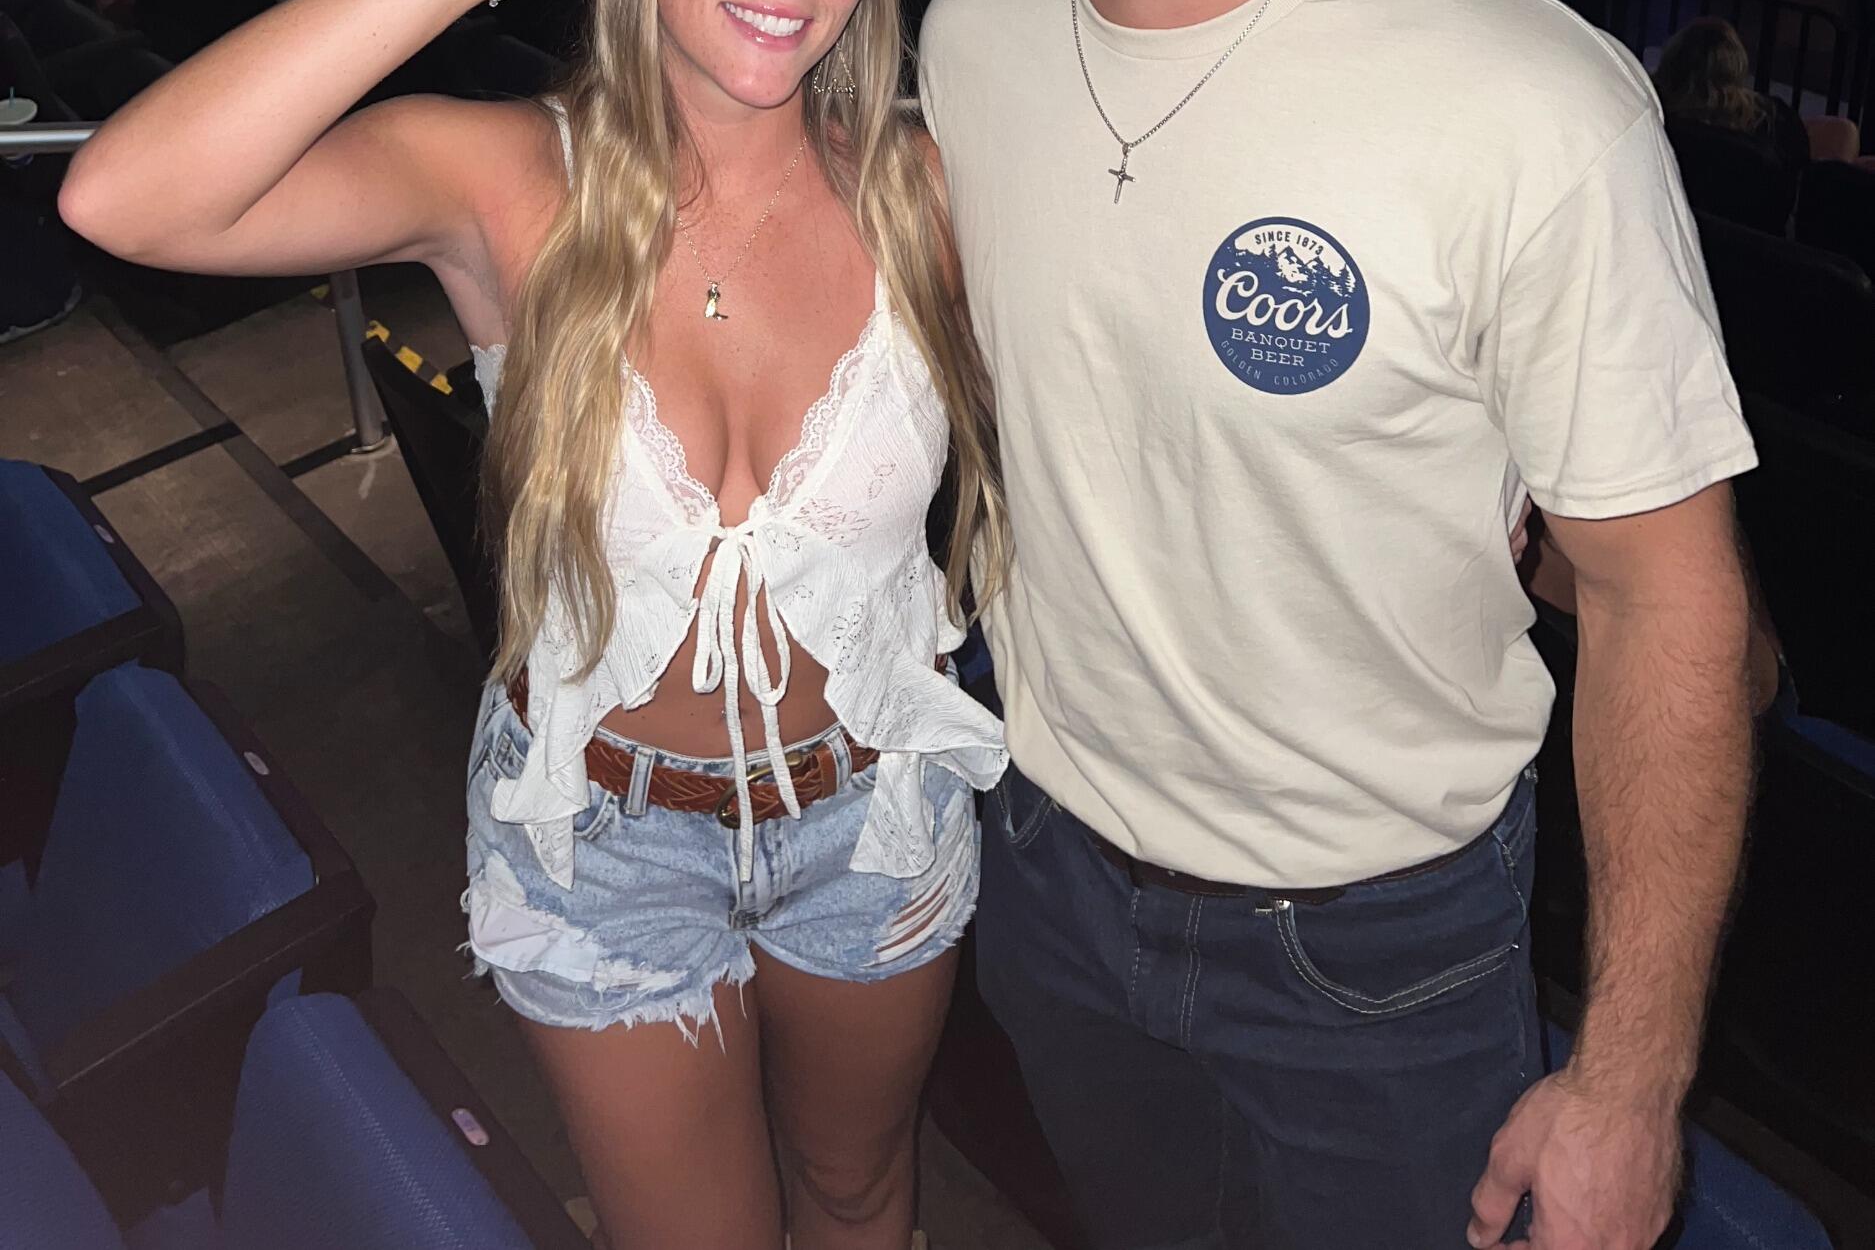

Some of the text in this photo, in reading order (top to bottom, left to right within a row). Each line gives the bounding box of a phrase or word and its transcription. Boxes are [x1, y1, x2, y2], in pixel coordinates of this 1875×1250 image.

[1255, 231, 1323, 256] SINCE 1873
[1216, 268, 1353, 338] Coors
[1231, 328, 1331, 354] BANQUET
[1220, 340, 1339, 386] GOLDEN COLORADO
[1251, 348, 1305, 367] BEER
